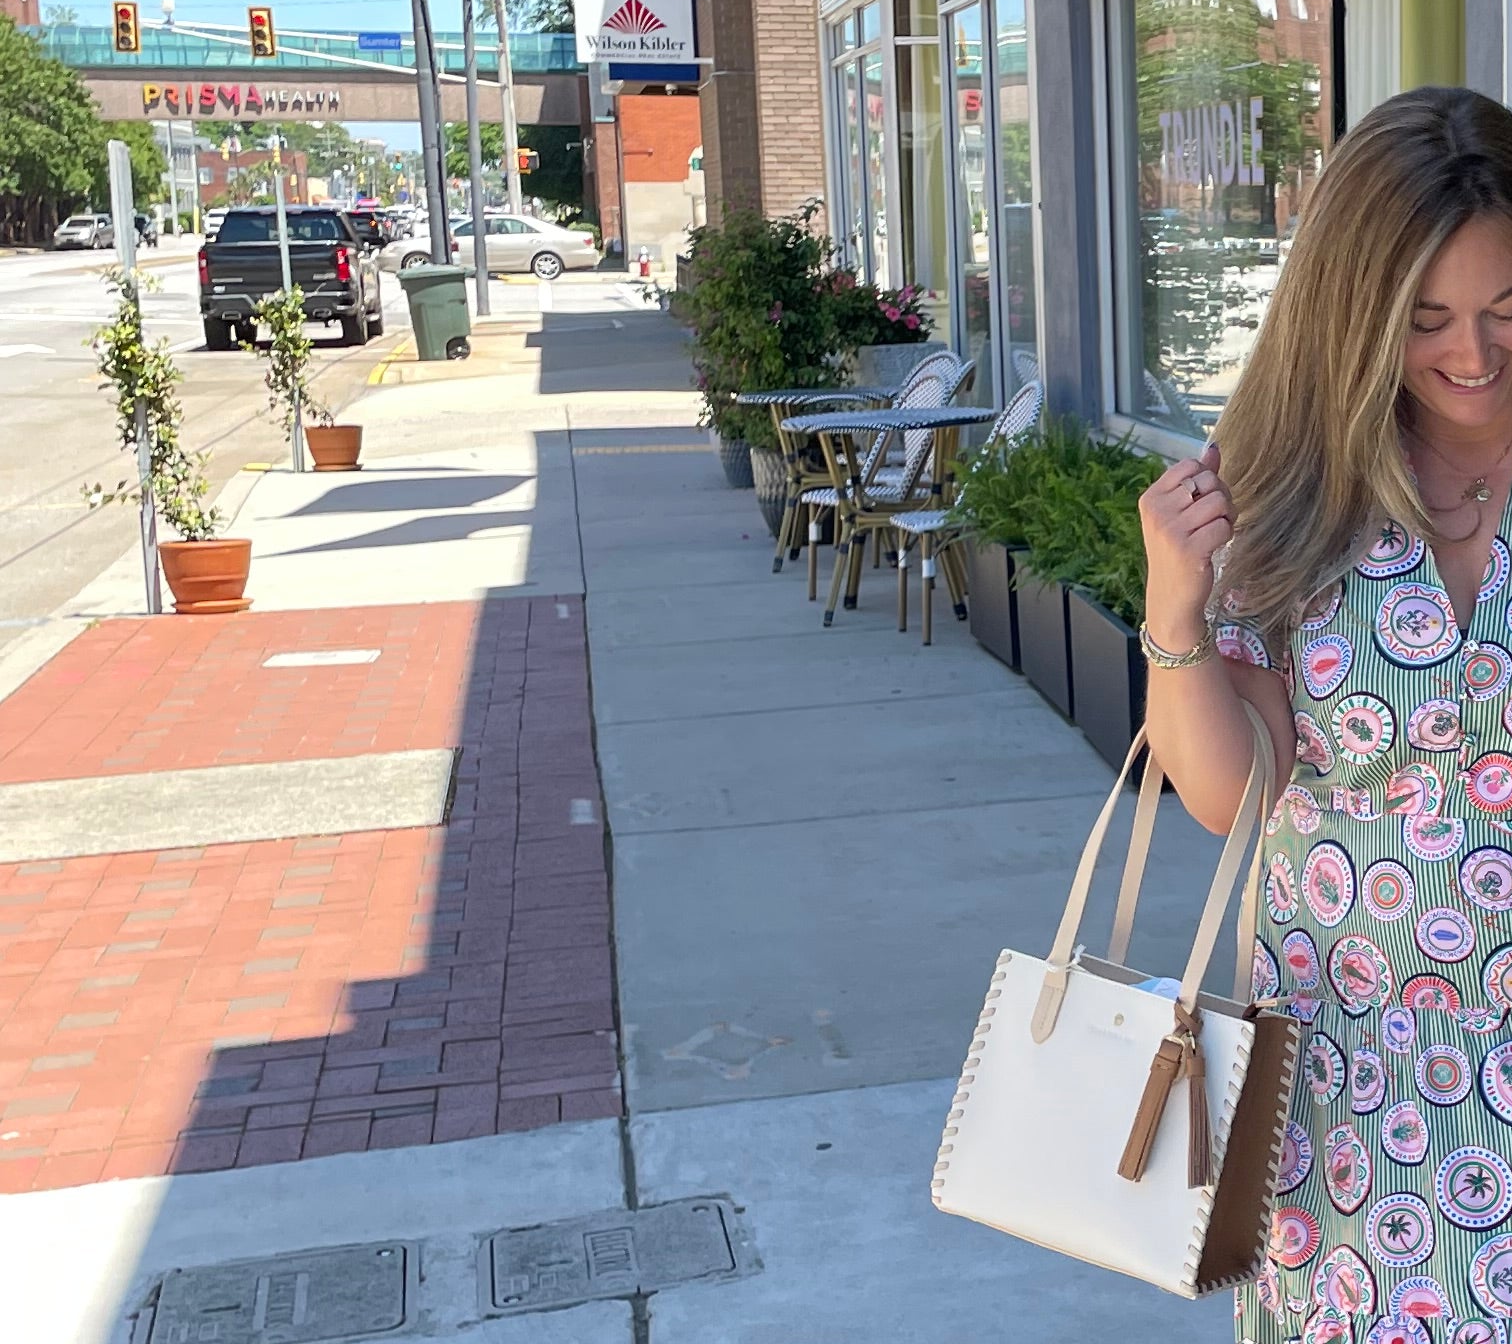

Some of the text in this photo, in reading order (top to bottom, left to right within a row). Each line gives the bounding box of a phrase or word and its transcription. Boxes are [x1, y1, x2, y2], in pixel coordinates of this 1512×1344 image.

[361, 35, 400, 48] Sumter
[586, 35, 686, 51] Wilson Kibler
[142, 82, 340, 106] PRISMA HEALTH
[1158, 95, 1265, 186] TRUNDLE
